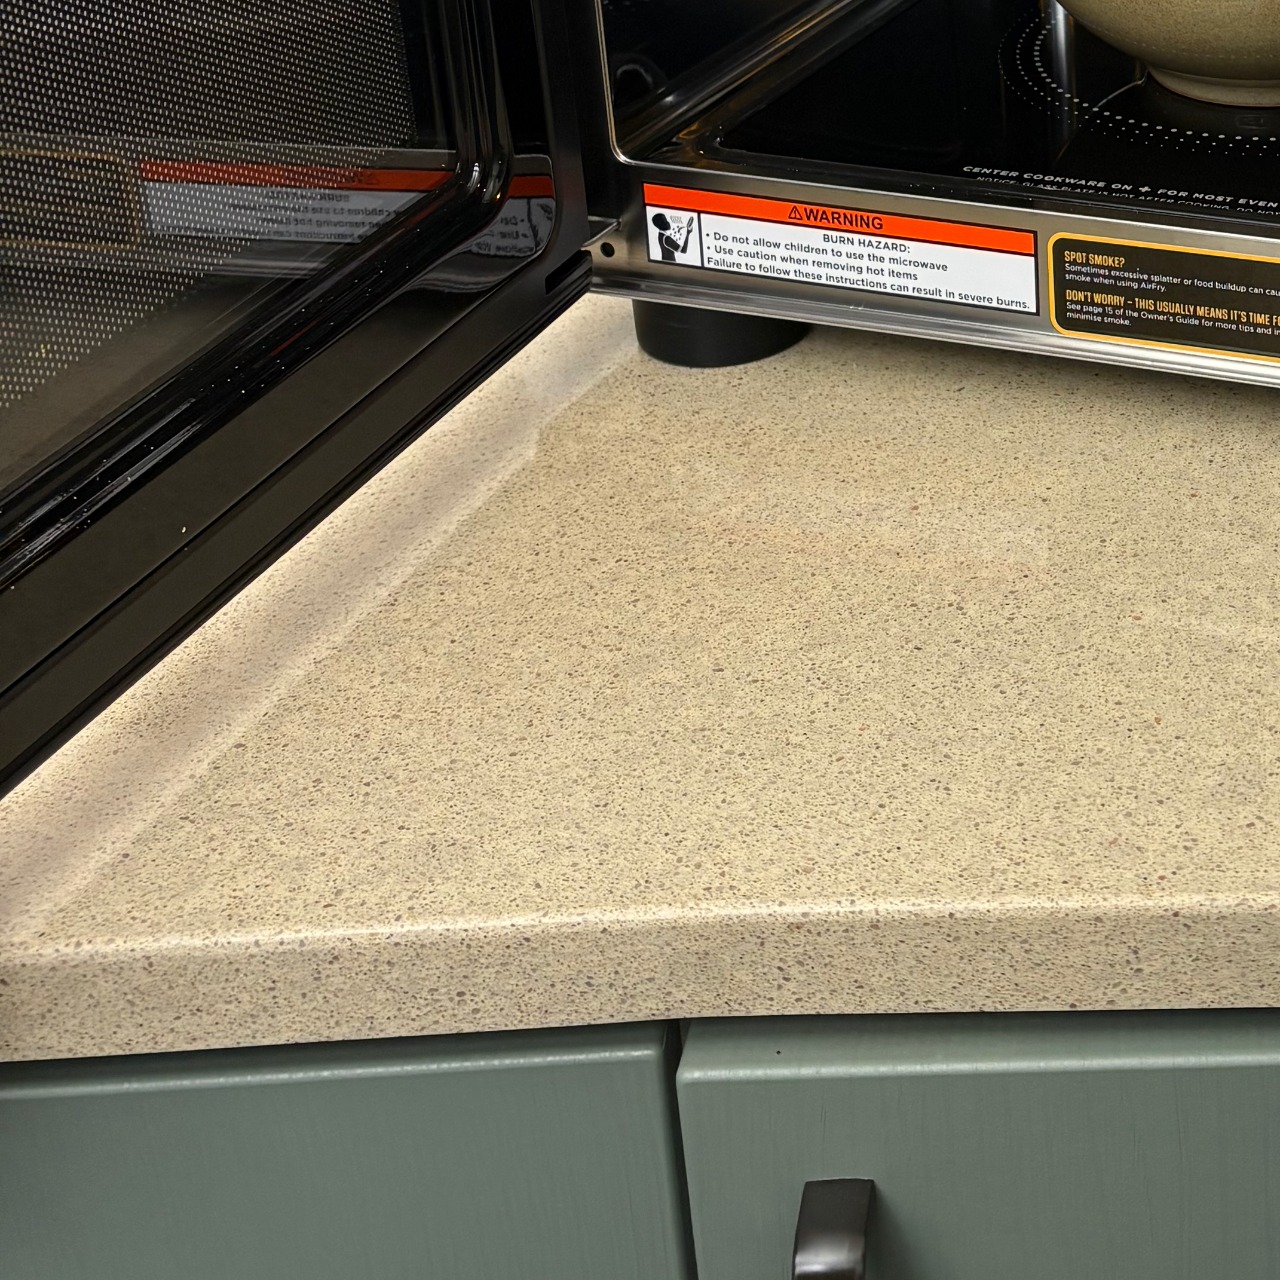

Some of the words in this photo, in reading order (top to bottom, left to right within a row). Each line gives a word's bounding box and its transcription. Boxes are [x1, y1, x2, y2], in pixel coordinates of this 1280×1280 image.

[962, 166, 1019, 177] CENTER
[1023, 173, 1106, 187] COOKWARE
[1157, 188, 1188, 197] FOR
[1192, 193, 1234, 202] MOST
[1238, 198, 1278, 208] EVEN
[804, 207, 883, 230] WARNING
[713, 231, 729, 242] Do
[732, 236, 750, 245] not
[752, 237, 781, 249] allow
[784, 242, 828, 256] children
[830, 248, 842, 258] to
[845, 251, 864, 260] use
[867, 253, 885, 263] the
[888, 256, 948, 272] microwave
[822, 233, 854, 246] BURN
[858, 238, 910, 254] HAZARD:
[1064, 250, 1086, 263] SPOT
[1088, 253, 1125, 268] SMOKE?
[714, 244, 734, 256] Use
[736, 249, 777, 262] caution
[780, 254, 809, 266] when
[812, 260, 863, 275] removing
[866, 265, 884, 276] hot
[888, 268, 918, 281] items
[706, 256, 742, 270] Failure
[746, 262, 756, 274] to
[758, 264, 790, 278] follow
[794, 268, 822, 281] these
[826, 274, 888, 290] instructions
[890, 283, 909, 293] can
[912, 286, 942, 297] result
[945, 289, 955, 299] in
[958, 292, 993, 304] severe
[996, 296, 1030, 309] burns.
[1093, 293, 1125, 306] WORRY
[1134, 298, 1154, 310] THIS
[1156, 300, 1194, 315] USUALLY
[1196, 305, 1228, 320] MEANS
[1248, 312, 1270, 325] TIME
